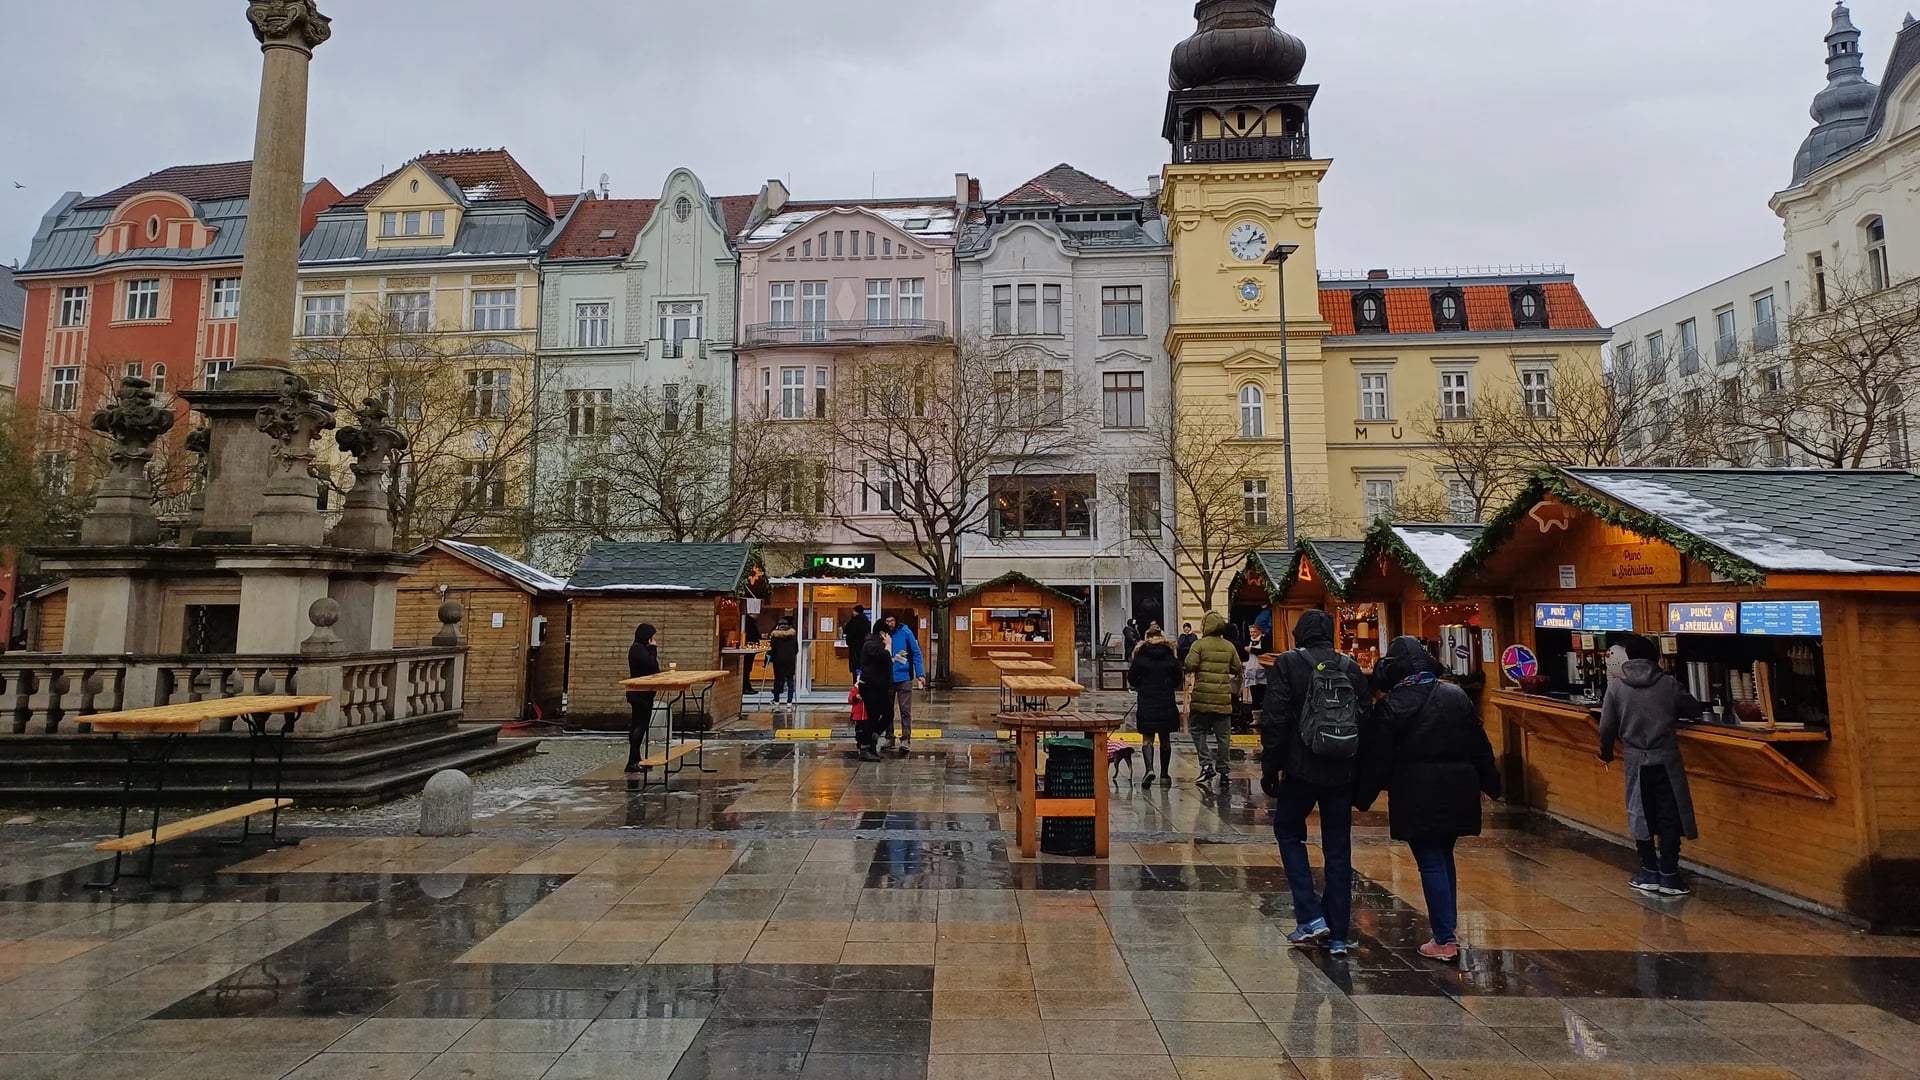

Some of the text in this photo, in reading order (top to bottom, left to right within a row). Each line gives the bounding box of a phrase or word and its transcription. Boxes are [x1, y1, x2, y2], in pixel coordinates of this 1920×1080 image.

[1355, 425, 1562, 440] MUSEUM
[1690, 605, 1712, 617] PUNČE
[1684, 619, 1723, 631] SNĚHULÁKA
